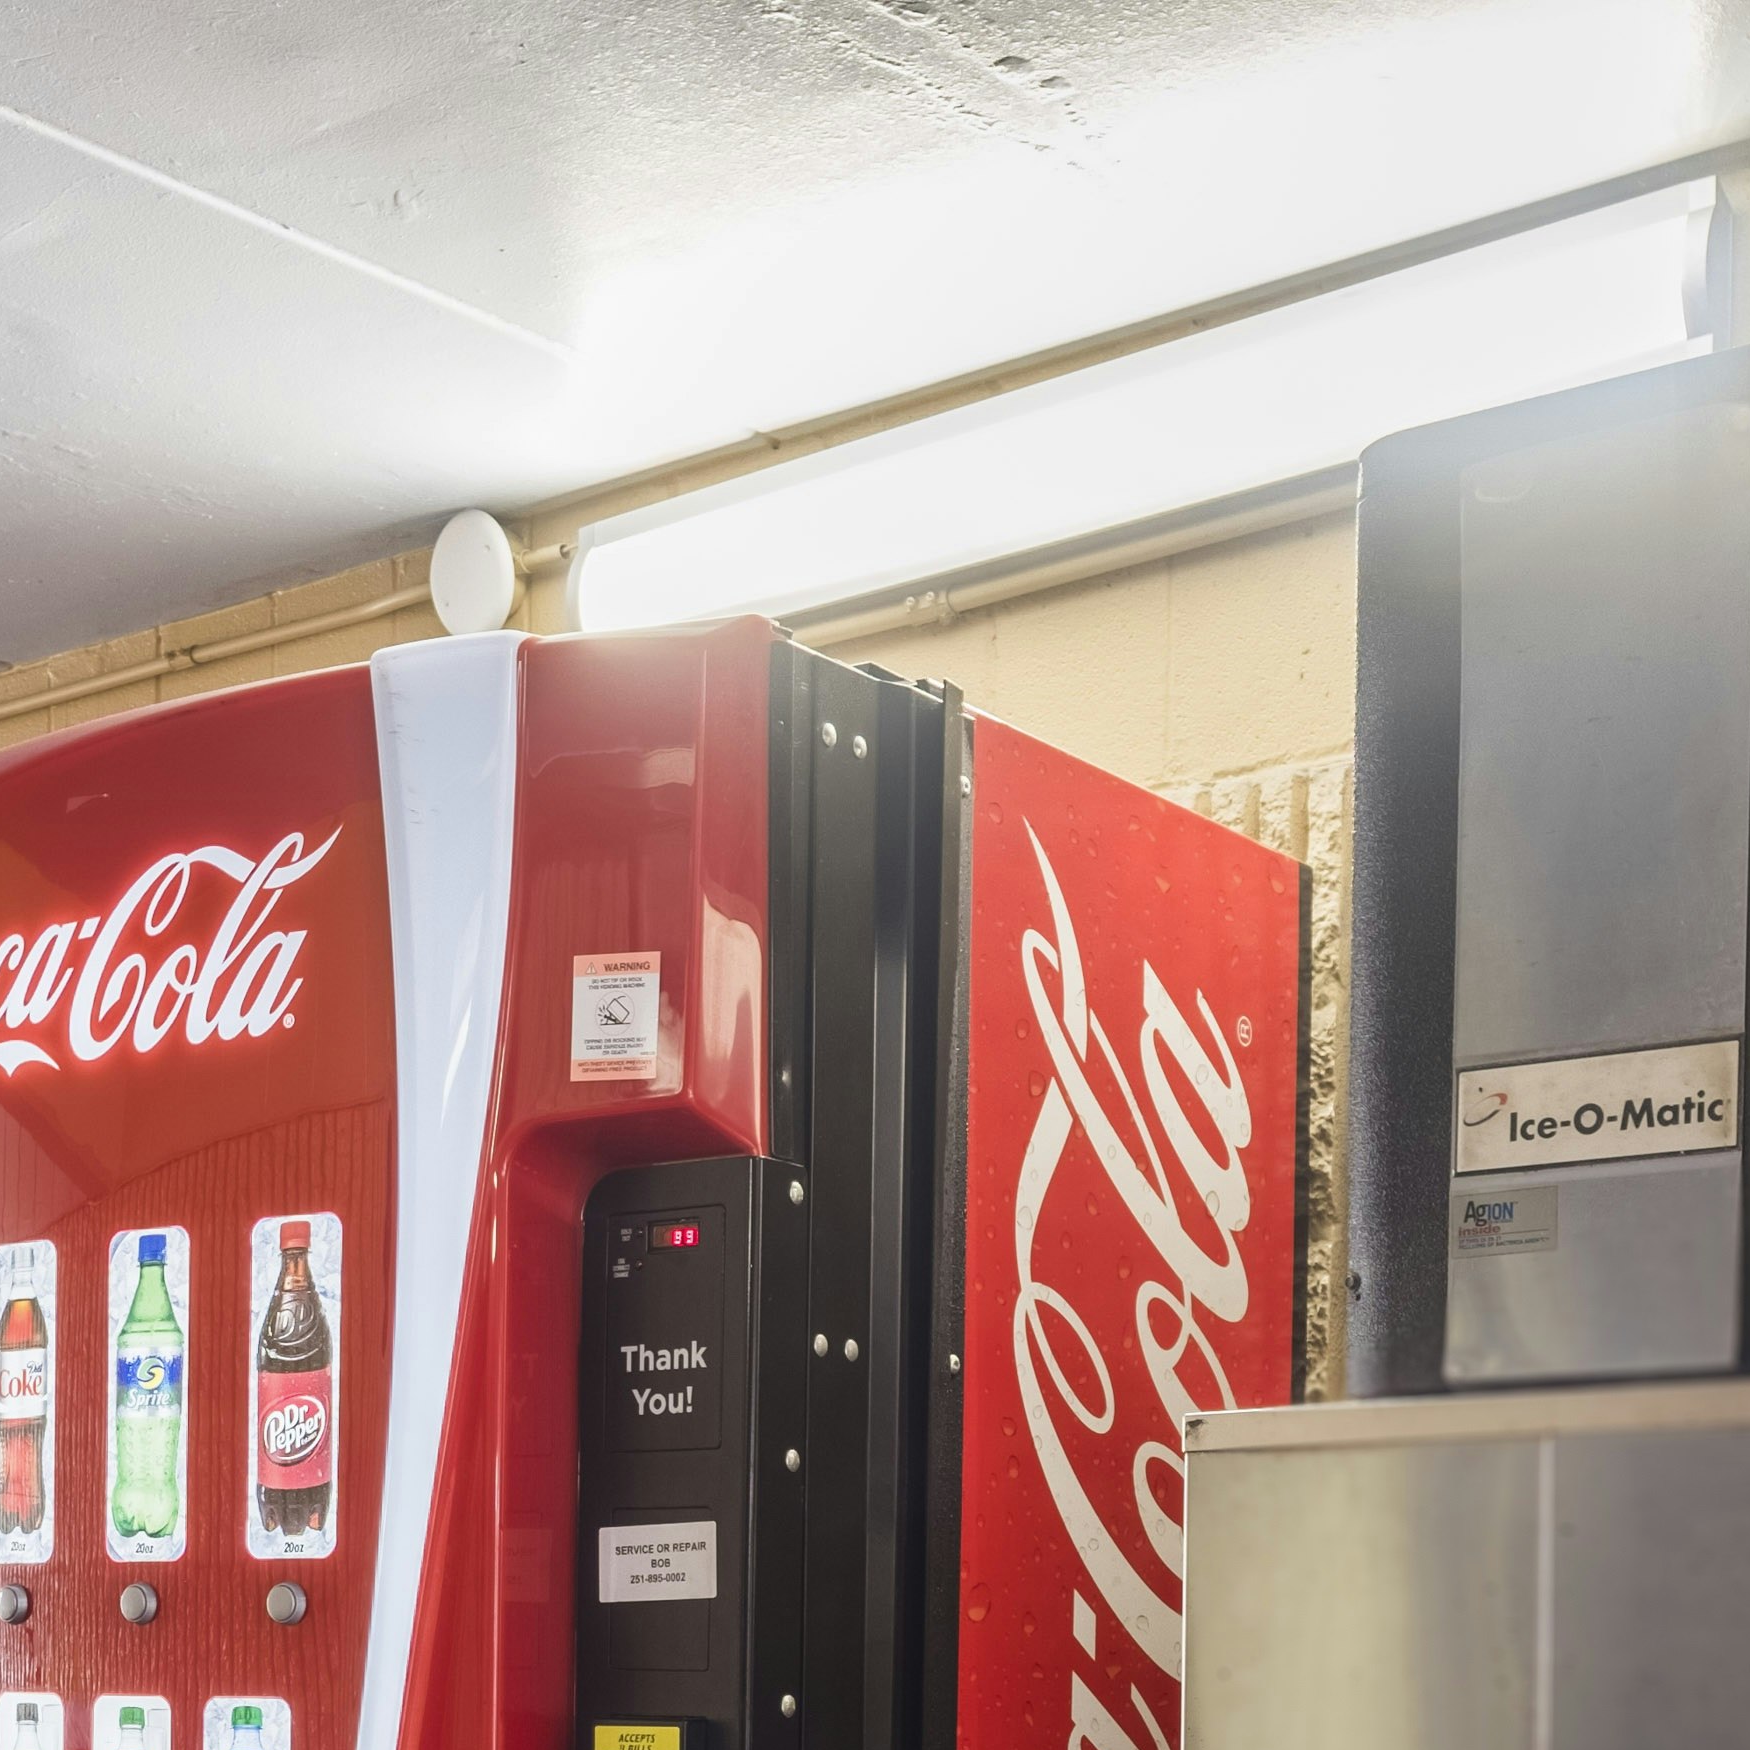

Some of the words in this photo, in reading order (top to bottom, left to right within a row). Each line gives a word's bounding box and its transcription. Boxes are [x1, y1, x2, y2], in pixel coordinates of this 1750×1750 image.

[603, 961, 651, 972] WARNING
[1509, 1089, 1724, 1142] Ice-O-Matic
[1458, 1225, 1501, 1237] inside
[620, 1340, 707, 1373] Thank
[0, 1369, 43, 1398] Coke
[127, 1388, 170, 1411] Sprite
[631, 1386, 693, 1416] You!
[284, 1404, 309, 1426] Dr
[268, 1410, 322, 1454] Pepper
[615, 1544, 654, 1556] SERVICE
[656, 1543, 670, 1554] OR
[672, 1541, 707, 1552] REPAIR
[650, 1558, 671, 1568] BOB
[630, 1572, 686, 1584] 251-895-0002
[618, 1734, 656, 1744] ACCEPTS
